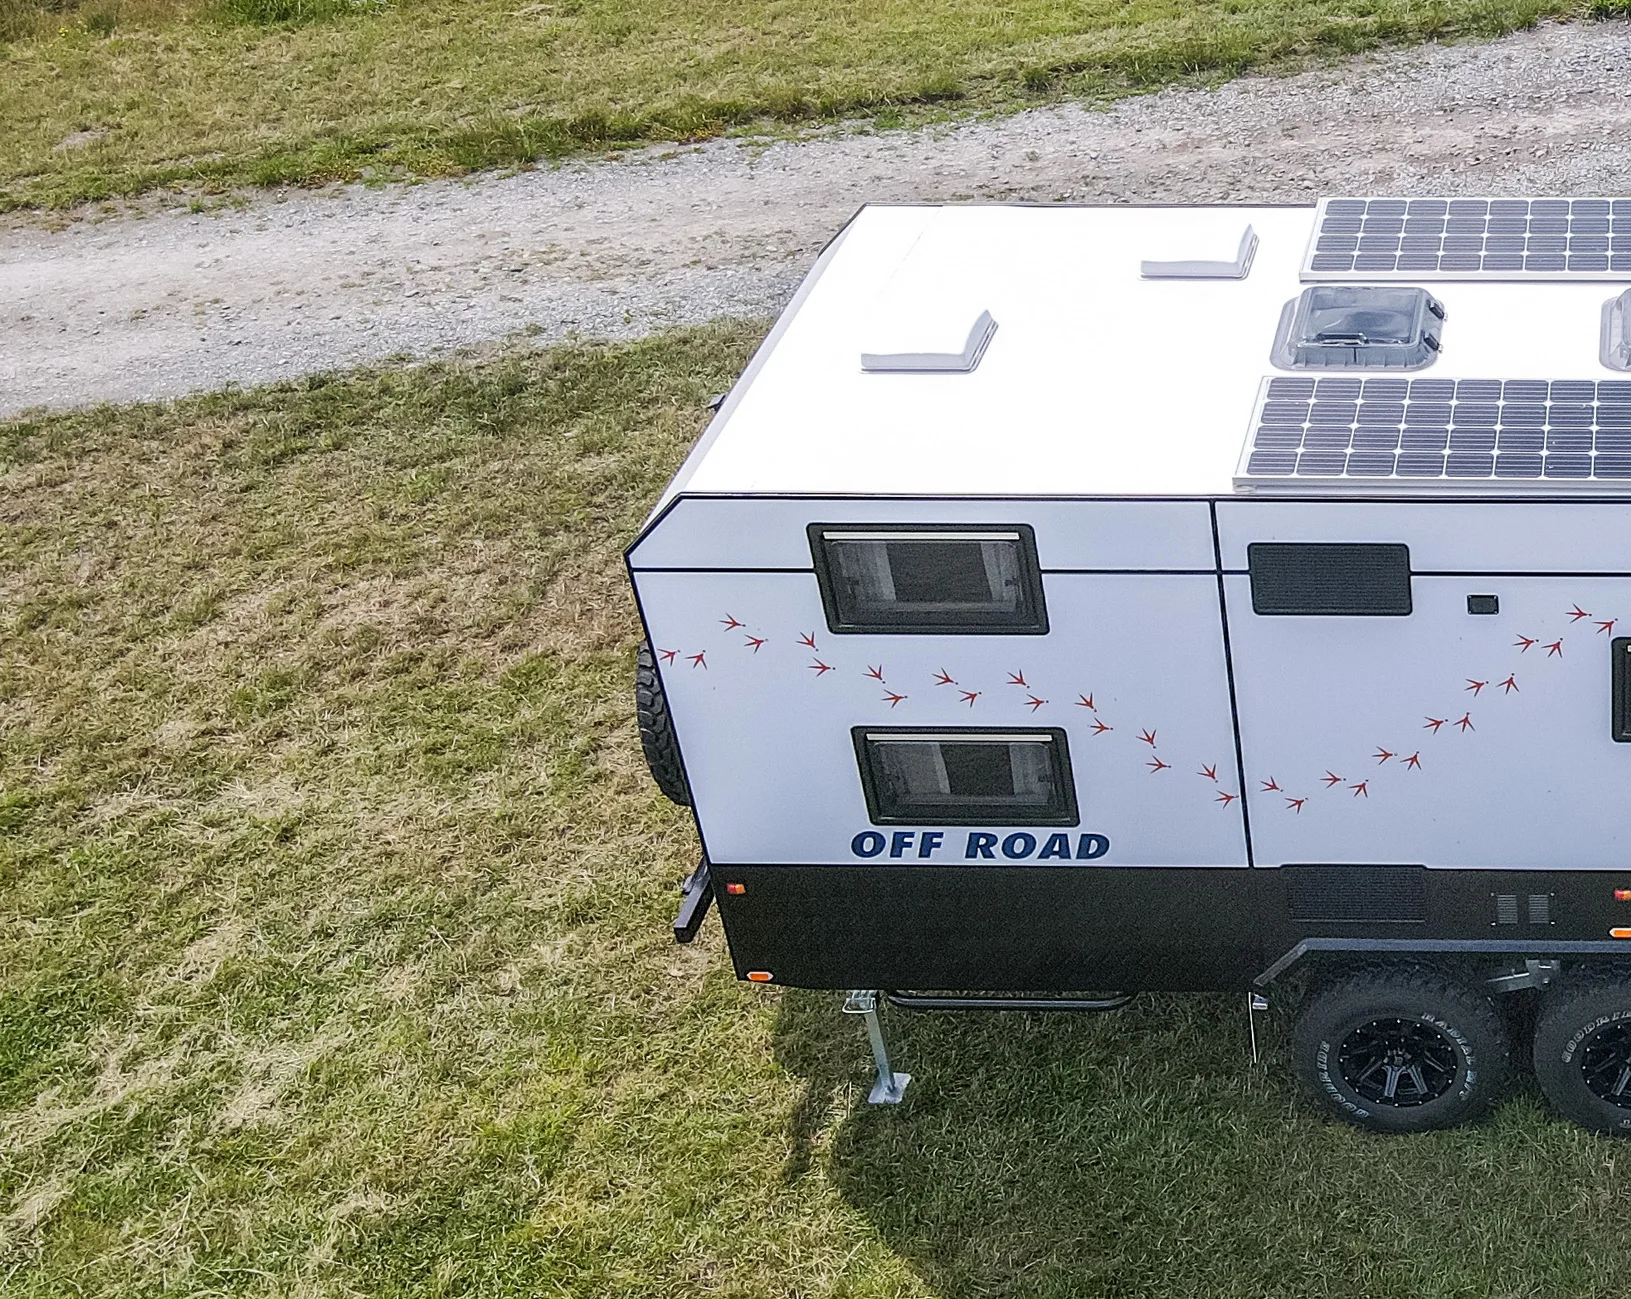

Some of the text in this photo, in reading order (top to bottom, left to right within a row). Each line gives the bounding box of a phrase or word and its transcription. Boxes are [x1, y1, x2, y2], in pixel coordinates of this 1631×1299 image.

[851, 830, 1111, 860] OFF ROAD
[1420, 1012, 1477, 1066] RADIAL
[1316, 1040, 1371, 1119] GOODRIDE
